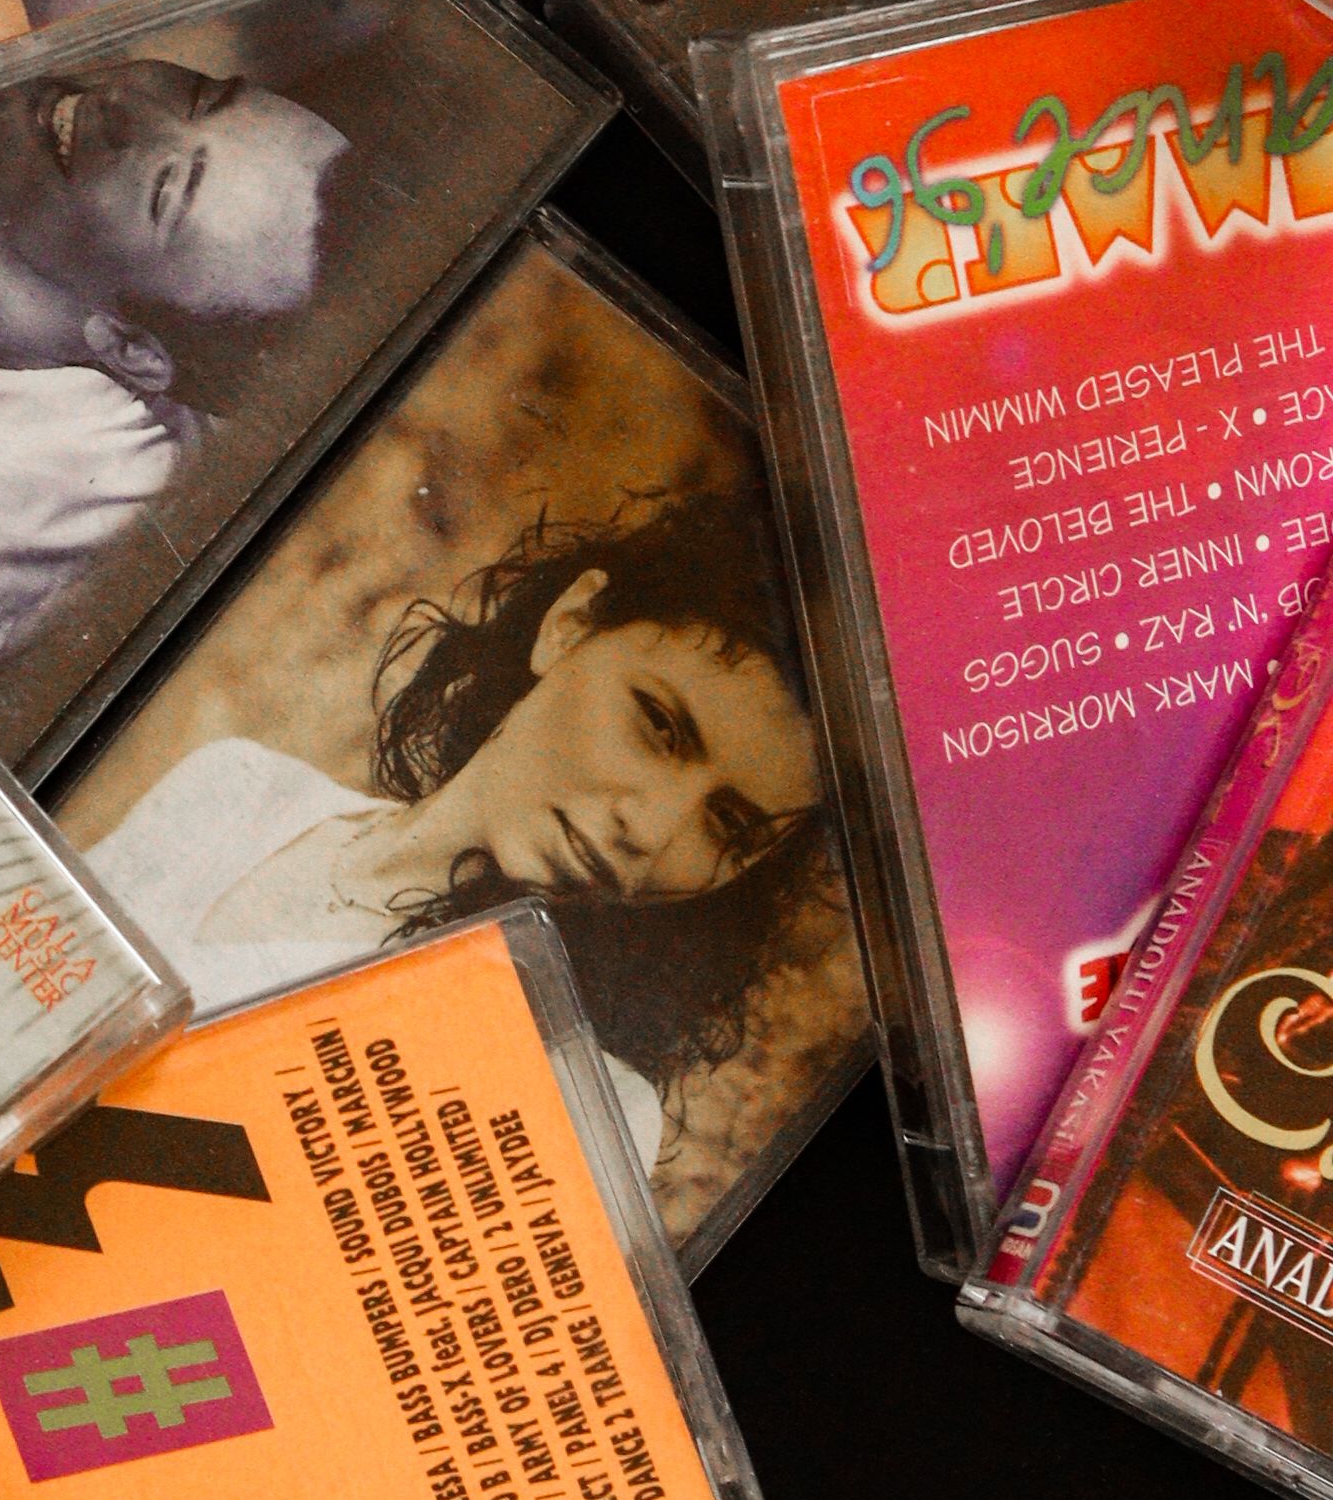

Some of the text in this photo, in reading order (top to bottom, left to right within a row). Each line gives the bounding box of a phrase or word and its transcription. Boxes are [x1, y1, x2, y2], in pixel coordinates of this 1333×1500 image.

[921, 323, 1325, 447] THE PLEASED WIMMIN
[943, 501, 1114, 569] BELOVED
[996, 562, 1125, 621] CIRCLE
[959, 629, 1105, 692] SUGGS
[939, 687, 1137, 762] MORRISON
[282, 1082, 347, 1187] VICTORY
[434, 1095, 506, 1221] UNLIMITED
[321, 1184, 376, 1264] SOUND
[357, 1149, 413, 1235] DUBOIS
[362, 1034, 560, 1489] ARMY LOVERS CAPTAIN HOLLYWOOD
[355, 1276, 421, 1384] BUMPERS
[567, 1313, 628, 1409] TRANCE
